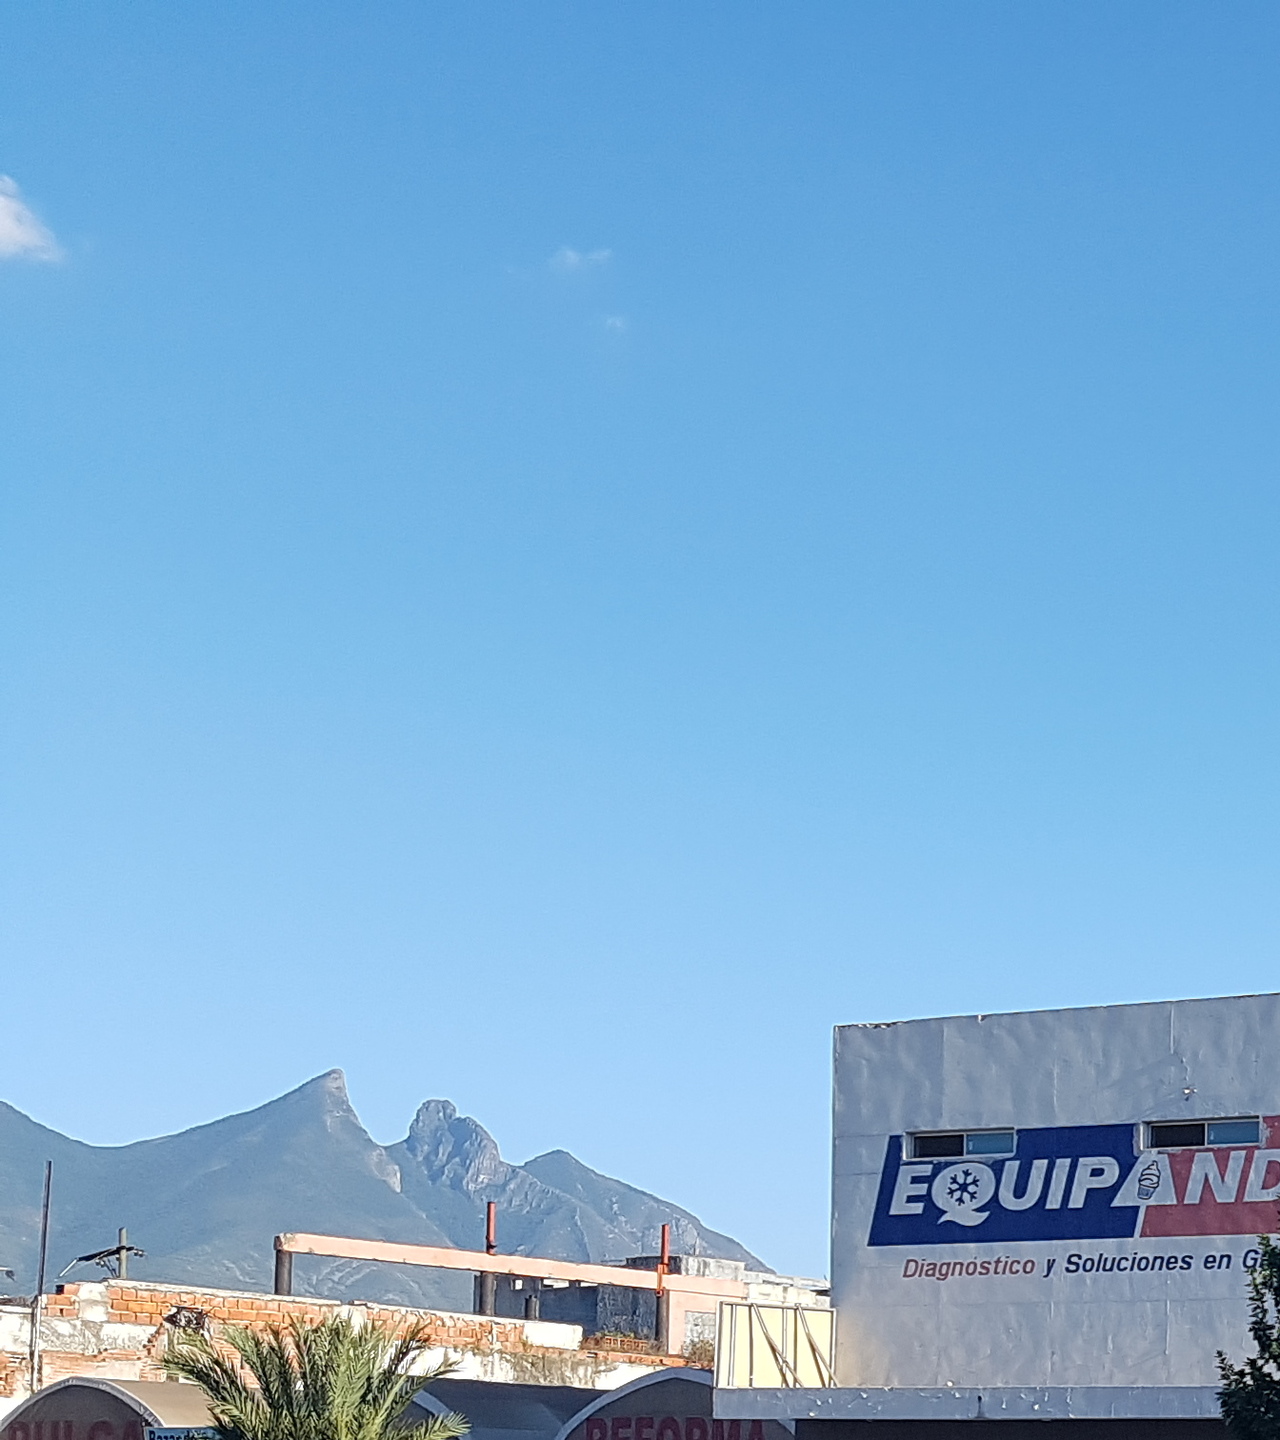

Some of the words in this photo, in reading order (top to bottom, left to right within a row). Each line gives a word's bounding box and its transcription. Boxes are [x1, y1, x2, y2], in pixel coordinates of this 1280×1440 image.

[903, 1256, 1036, 1281] Diagnóstico
[1043, 1257, 1056, 1278] y
[1064, 1252, 1194, 1274] Soluciones
[1203, 1251, 1231, 1271] en
